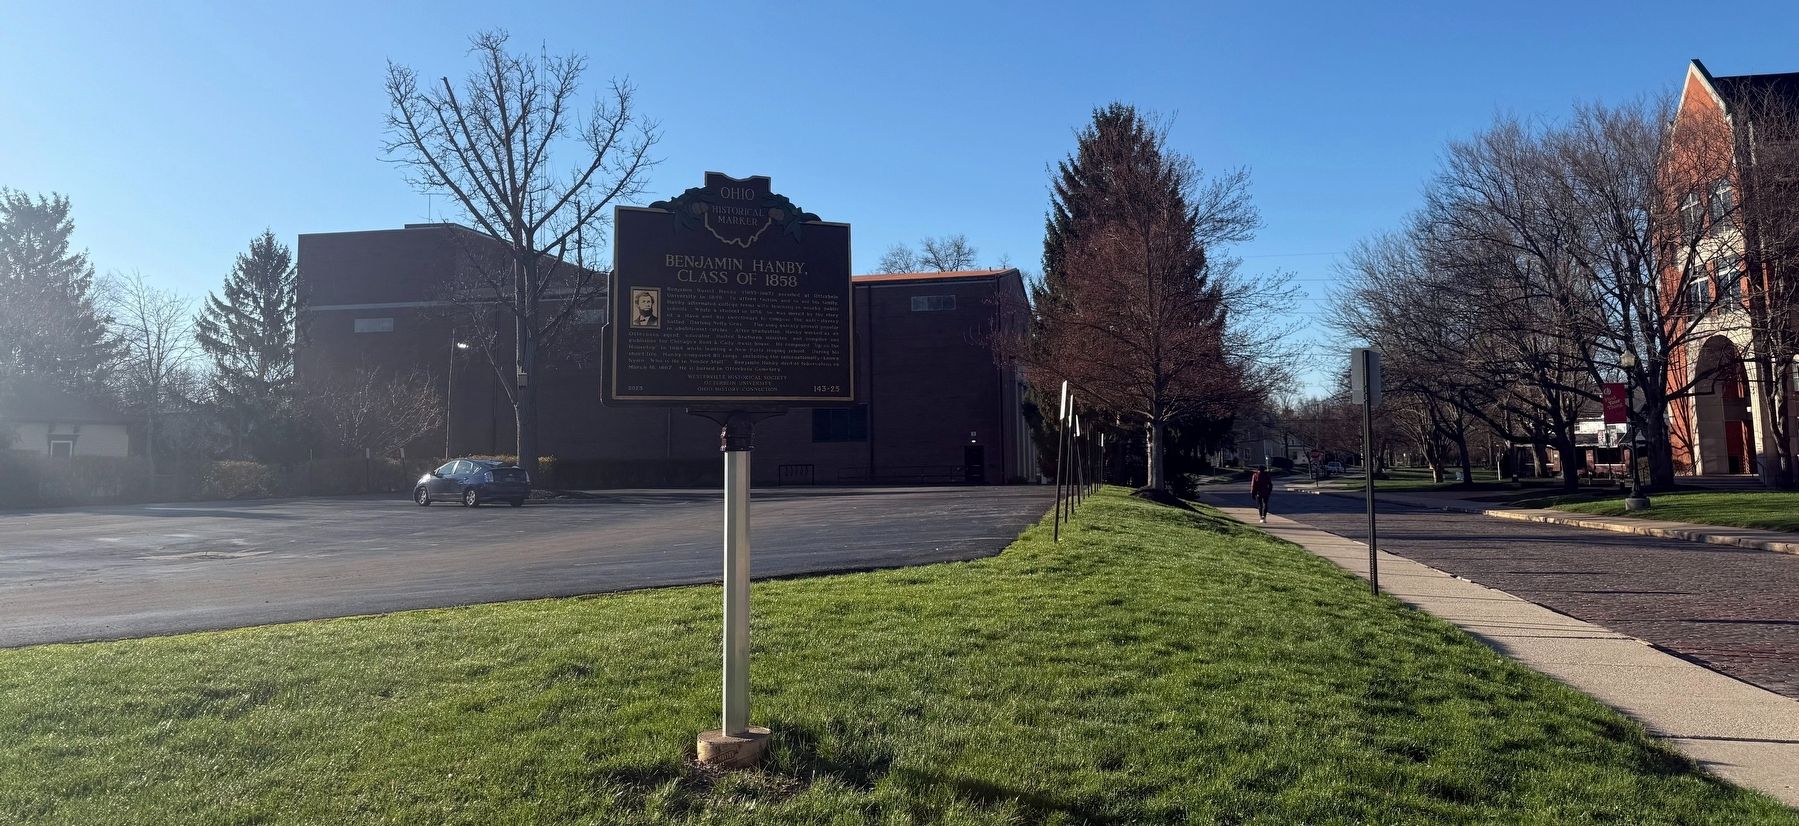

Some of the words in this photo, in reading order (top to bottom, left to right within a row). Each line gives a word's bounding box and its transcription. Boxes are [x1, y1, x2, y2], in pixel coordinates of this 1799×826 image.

[720, 187, 754, 201] OHIO
[712, 206, 765, 217] HISTORICAL
[718, 215, 758, 226] MARKER
[666, 254, 742, 272] BENJAMIN
[753, 260, 807, 275] HANBY,
[678, 270, 728, 284] CLASS
[737, 273, 756, 285] OF
[765, 275, 798, 287] 1858
